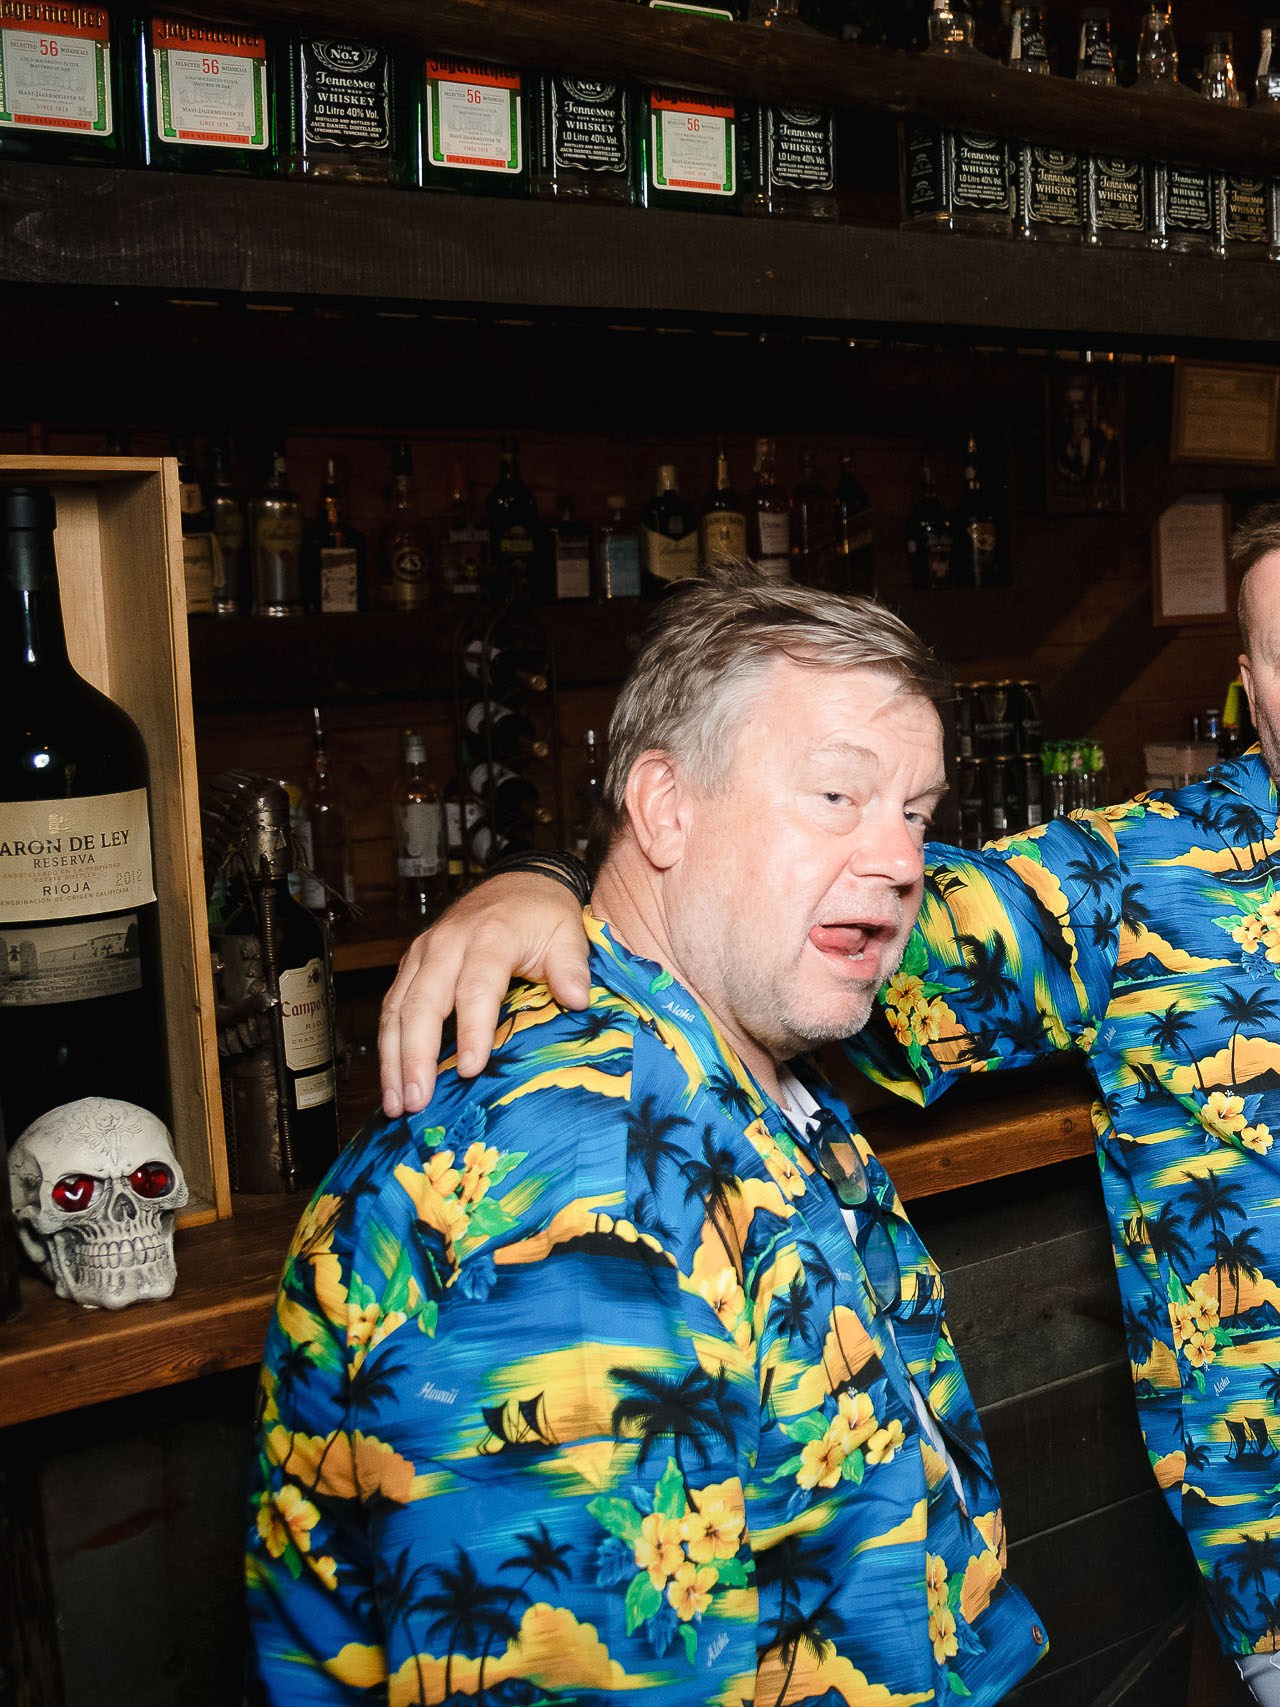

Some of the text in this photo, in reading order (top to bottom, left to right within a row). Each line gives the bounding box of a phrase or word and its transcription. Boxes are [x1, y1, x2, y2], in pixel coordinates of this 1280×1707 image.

[40, 40, 58, 56] 56
[202, 58, 219, 75] 56
[315, 71, 376, 90] Tennessee
[317, 92, 376, 107] WHISKEY
[467, 89, 481, 104] 56
[314, 104, 325, 114] 1.0
[326, 105, 345, 116] Litre
[346, 107, 365, 119] 40%
[564, 101, 616, 118] Tennessee
[565, 120, 615, 133] WHISKEY
[688, 118, 700, 132] 56
[780, 124, 824, 140] Tennessee
[573, 132, 590, 143] Litre
[590, 134, 606, 144] 40%
[781, 142, 824, 154] WHISKEY
[960, 148, 1001, 162] Tennessee
[962, 164, 1000, 176] WHISKEY
[1037, 168, 1077, 184] Tennessee
[1036, 184, 1078, 197] WHISKEY
[1100, 175, 1138, 191] Tennessee
[1098, 190, 1139, 203] WHISKEY
[1172, 186, 1204, 198] WHISKEY
[1230, 204, 1266, 216] WHISKEY
[70, 835, 96, 851] DE
[101, 830, 130, 848] LEY
[33, 854, 96, 869] RESERVA
[115, 868, 143, 887] 2012
[42, 882, 91, 896] RIOJA
[66, 893, 94, 901] ORIGEN
[96, 887, 129, 897] CALIFICADA
[662, 1001, 696, 1022] Aloha
[418, 1382, 459, 1405] Hawaii
[1213, 1377, 1230, 1397] Aloha
[708, 1632, 730, 1669] Aloha
